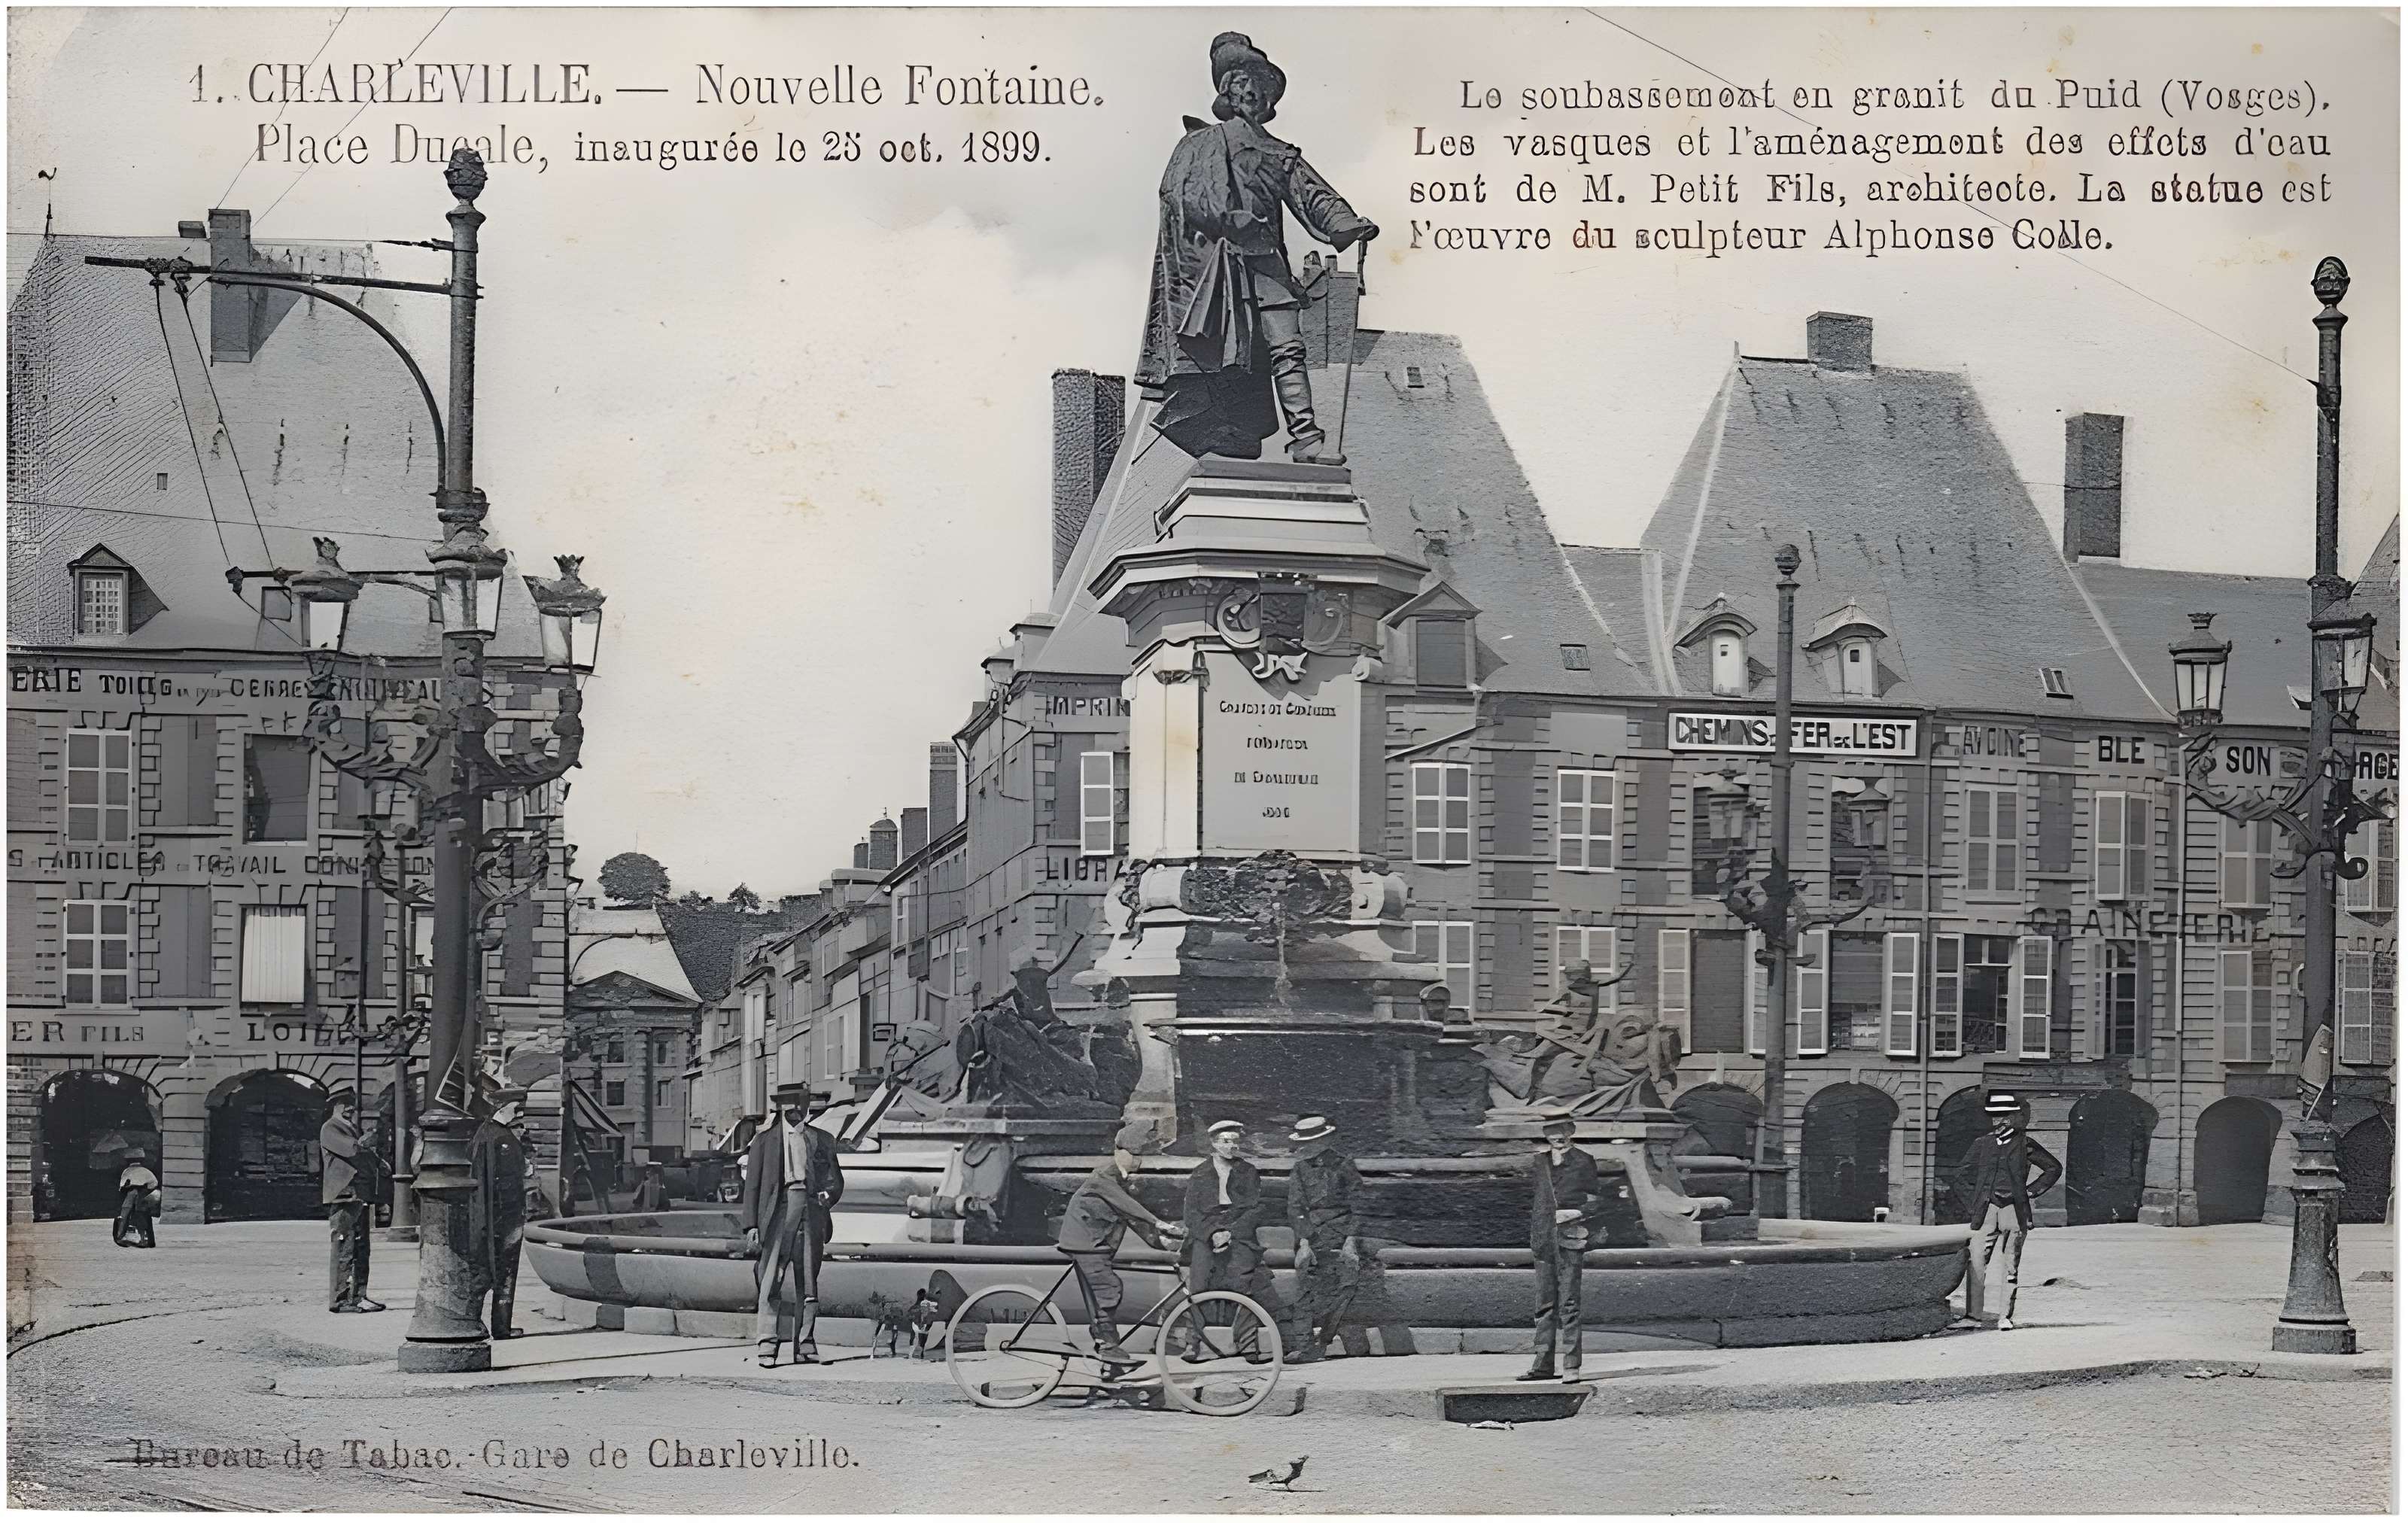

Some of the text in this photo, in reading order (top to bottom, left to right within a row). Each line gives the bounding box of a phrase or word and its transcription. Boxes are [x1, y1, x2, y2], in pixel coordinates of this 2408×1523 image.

[1789, 721, 1832, 748] FER
[1853, 722, 1912, 750] L'EST
[2225, 746, 2272, 777] SON
